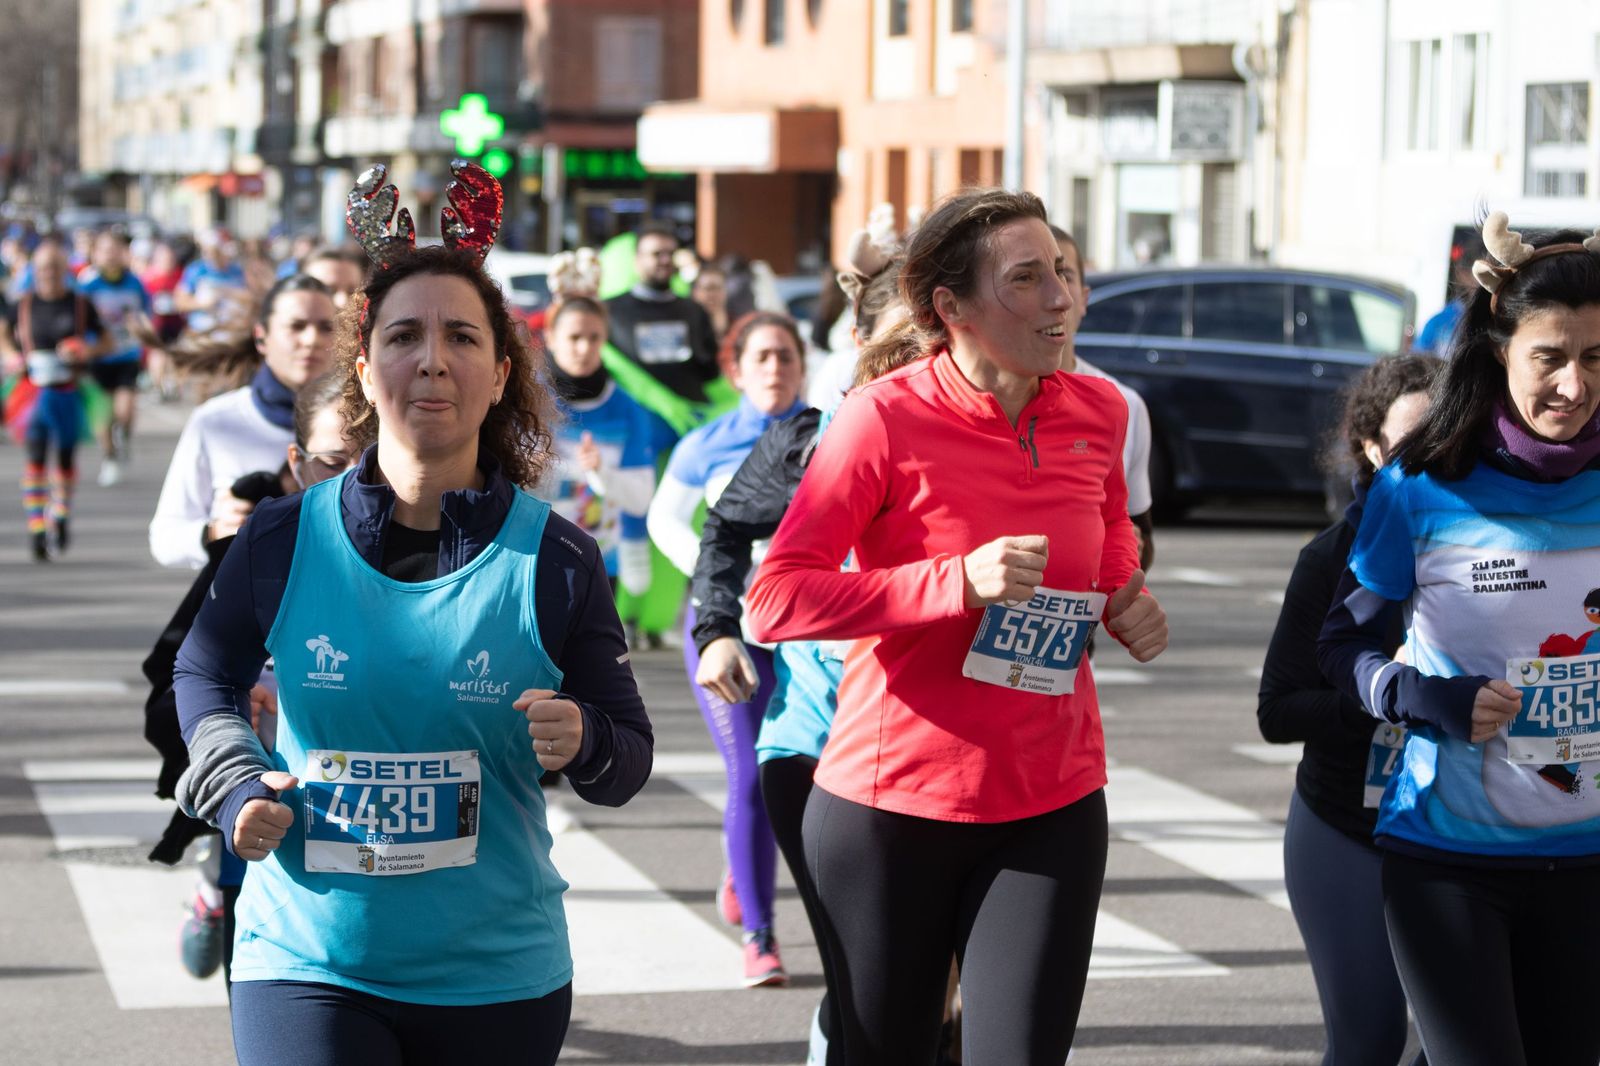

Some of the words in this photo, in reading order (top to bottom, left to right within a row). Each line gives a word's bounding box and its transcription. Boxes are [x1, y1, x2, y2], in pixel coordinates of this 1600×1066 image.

[560, 536, 583, 556] KIPRUN
[1471, 561, 1489, 571] XLI
[1491, 558, 1515, 569] SAN
[1472, 569, 1529, 582] SILVESTRE
[1473, 580, 1547, 593] SALMANTINA
[1027, 594, 1093, 616] SETEL
[993, 610, 1078, 662] 5573
[1023, 673, 1055, 684] Ayuntamiento
[449, 678, 511, 696] maristas
[1027, 682, 1052, 692] Salamanca
[457, 693, 499, 705] Salamanca
[1527, 682, 1600, 729] 485
[350, 759, 462, 780] SETEL
[325, 785, 436, 834] 4439
[366, 834, 394, 844] ELSA
[377, 853, 425, 864] Ayuntamiento
[378, 863, 386, 872] de
[387, 862, 425, 872] Salamanca
